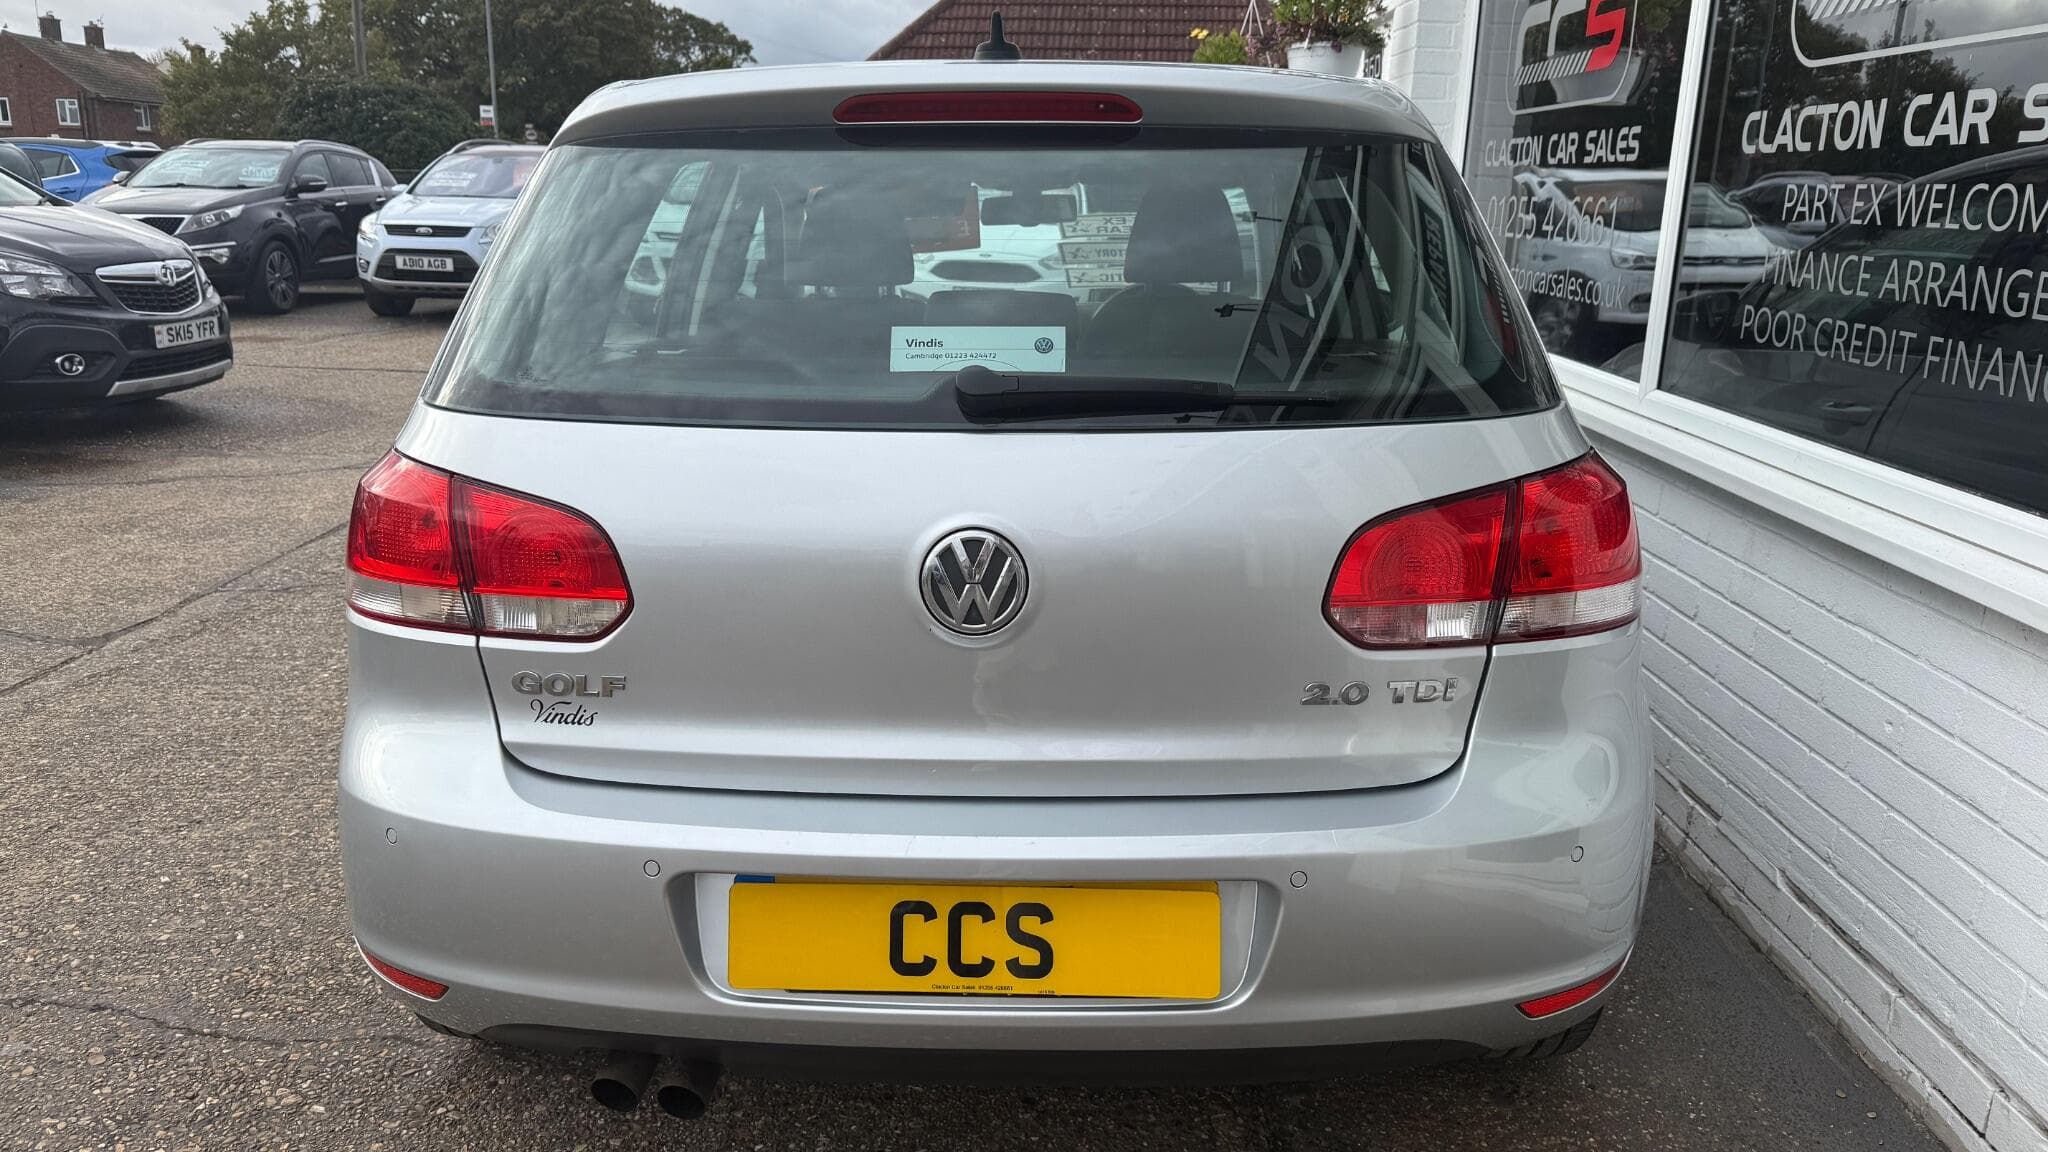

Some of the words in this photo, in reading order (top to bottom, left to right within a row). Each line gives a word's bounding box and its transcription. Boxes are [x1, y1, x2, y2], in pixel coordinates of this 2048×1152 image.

[1742, 98, 1888, 154] CLACTON
[1903, 87, 1998, 147] CAR
[1485, 136, 1543, 168] CLACTON
[1547, 132, 1579, 164] CAR
[1583, 125, 1642, 163] SALES
[1488, 195, 1538, 239] 01255
[1541, 196, 1618, 244] 426661
[1781, 183, 1846, 222] PART
[1850, 183, 1888, 225] EX
[1761, 248, 1875, 297] FINANCE
[166, 324, 194, 343] SK15
[195, 320, 216, 338] YFR
[905, 338, 944, 348] Vindis
[905, 352, 943, 360] Cambridge
[969, 352, 997, 360] 424472
[1739, 304, 1806, 352] POOR
[1814, 317, 1918, 374] CREDIT
[1923, 335, 2048, 402] FINAN
[511, 670, 627, 698] GOLF
[1300, 680, 1370, 705] 2.0
[1387, 677, 1459, 704] TDI
[530, 699, 598, 726] Vindis
[889, 900, 1054, 979] CCS
